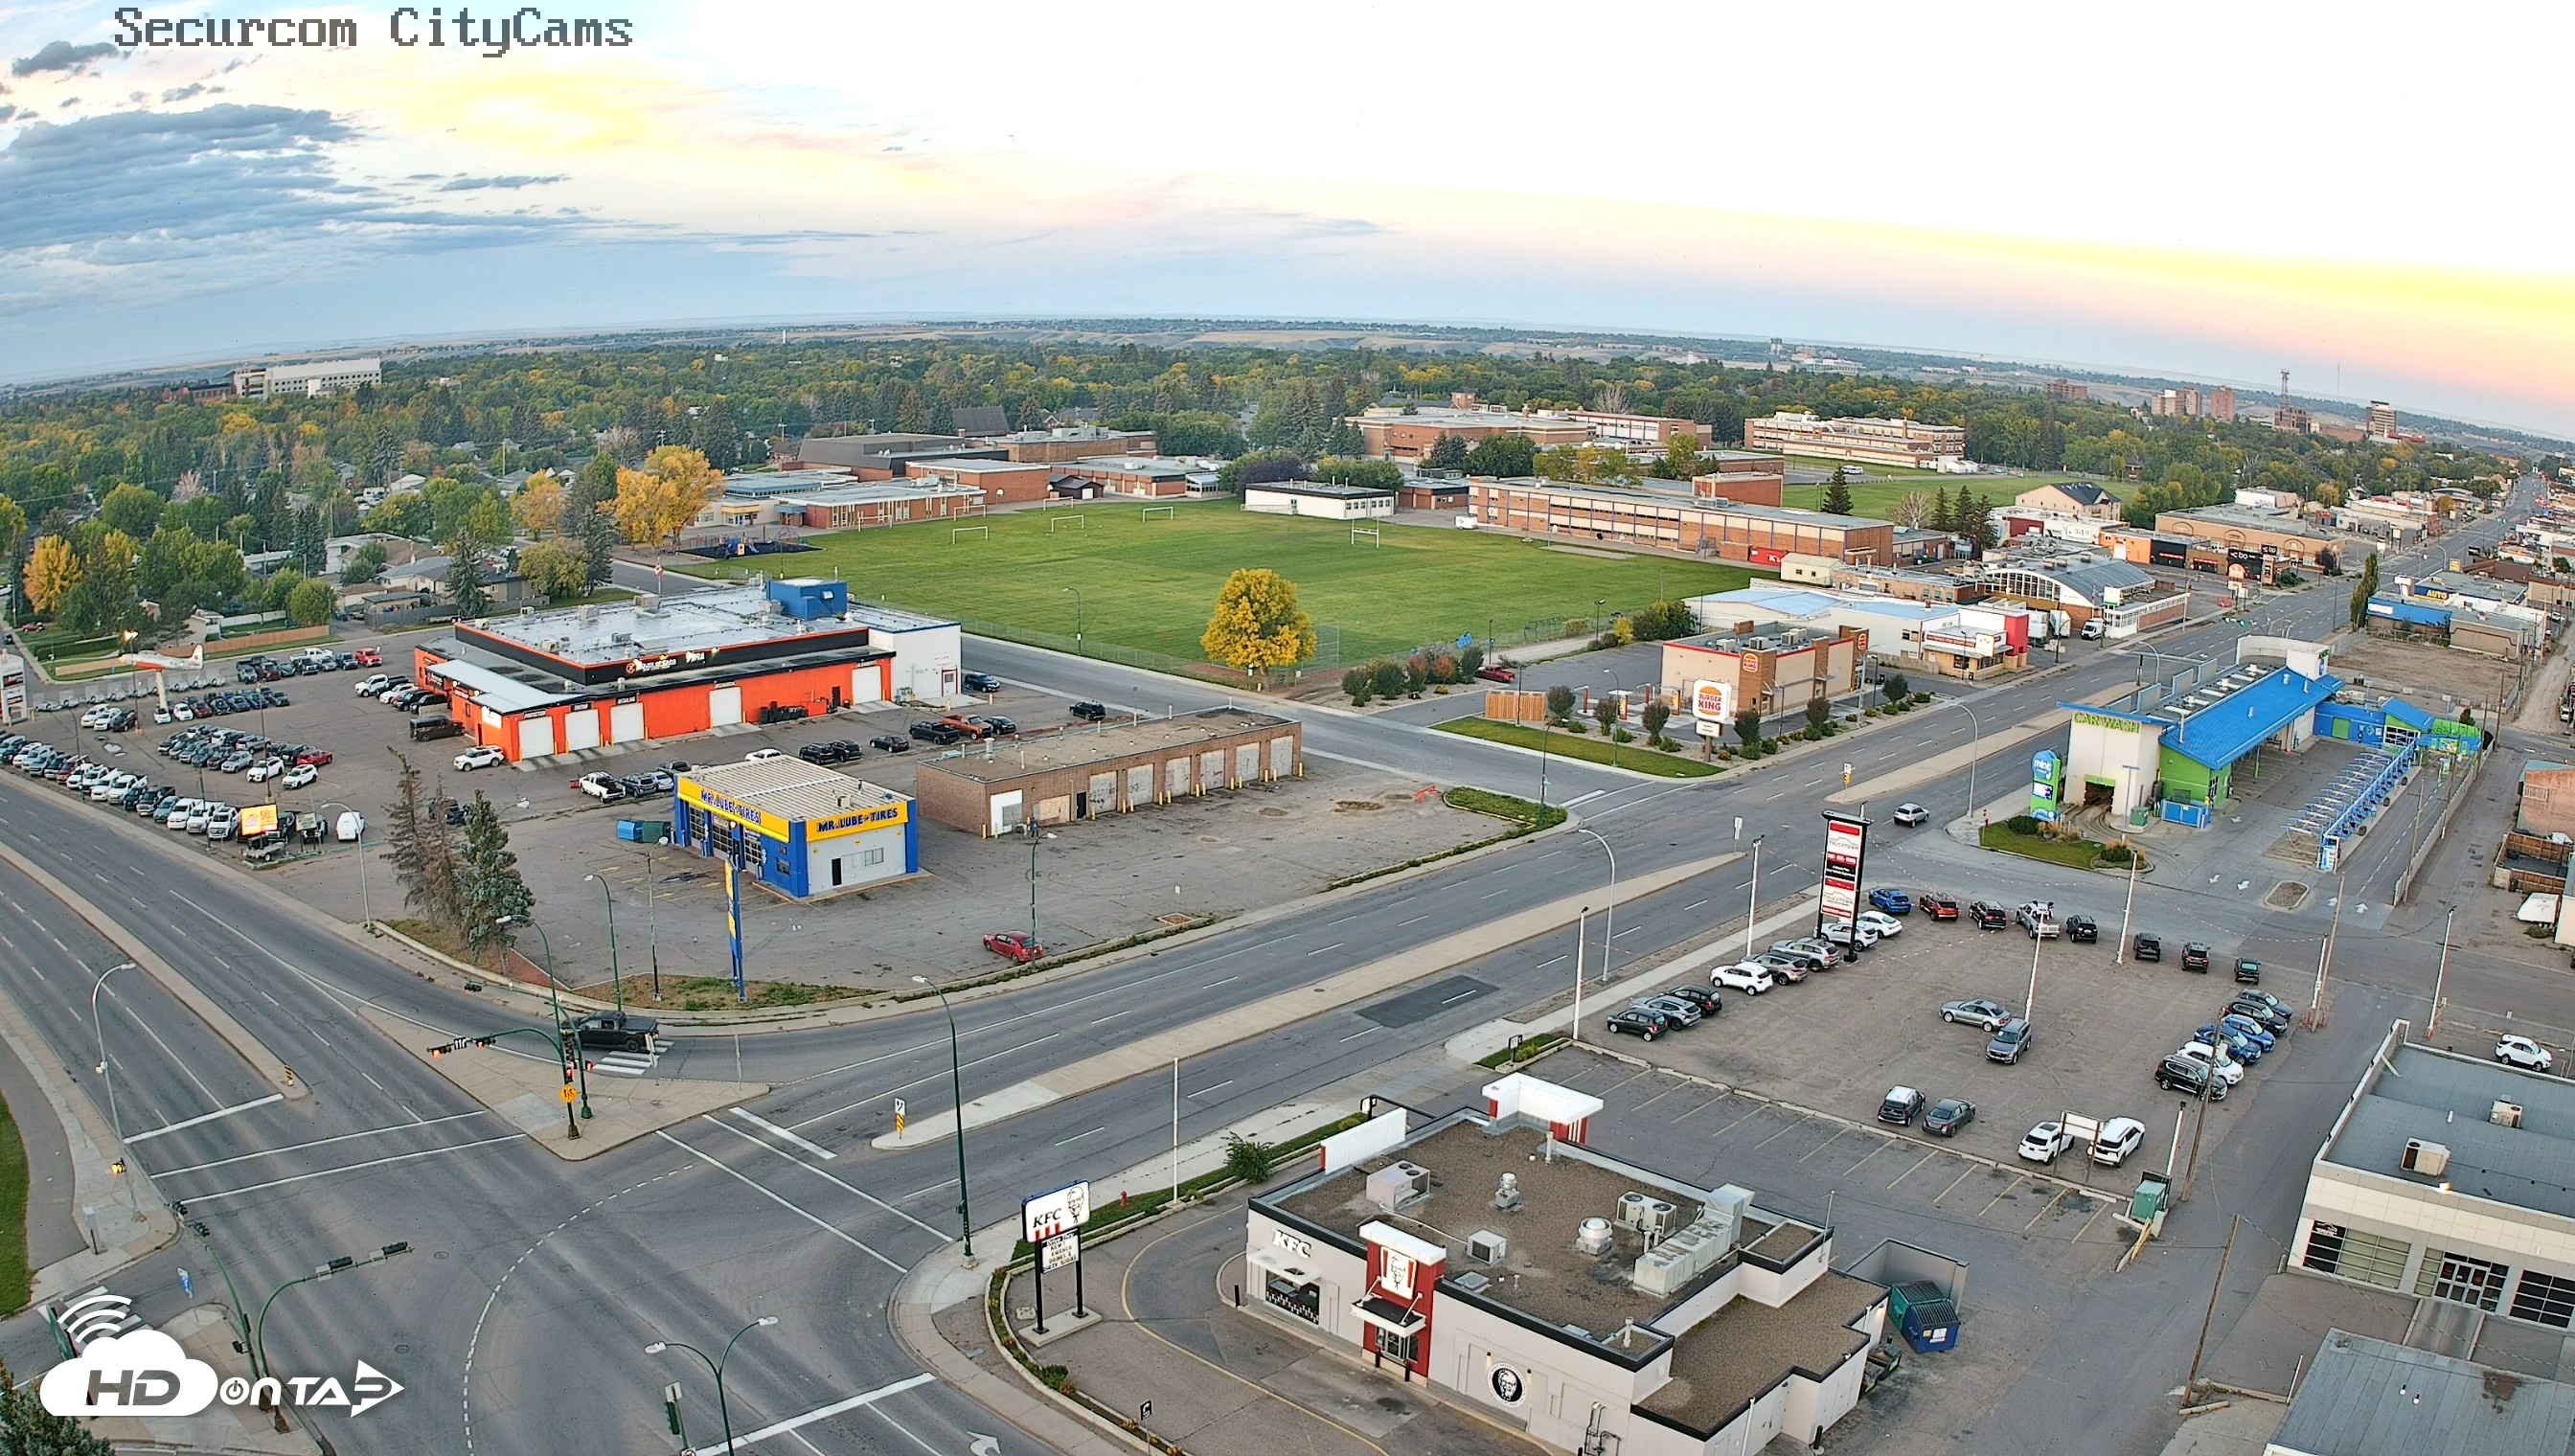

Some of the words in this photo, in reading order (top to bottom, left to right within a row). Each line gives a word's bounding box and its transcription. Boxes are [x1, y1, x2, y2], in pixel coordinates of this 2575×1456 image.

[2427, 590, 2448, 600] AUTO
[1698, 693, 1722, 703] BURGER
[1698, 699, 1721, 711] KING
[2074, 712, 2099, 726] CAR
[2102, 717, 2140, 734] WASH
[2034, 758, 2052, 769] mint
[716, 794, 735, 815] LUBE
[738, 804, 762, 826] TIRES
[838, 813, 863, 829] LUBE
[870, 808, 899, 822] TIRES
[1033, 1208, 1062, 1228] KFC
[1272, 1228, 1311, 1259] KFC
